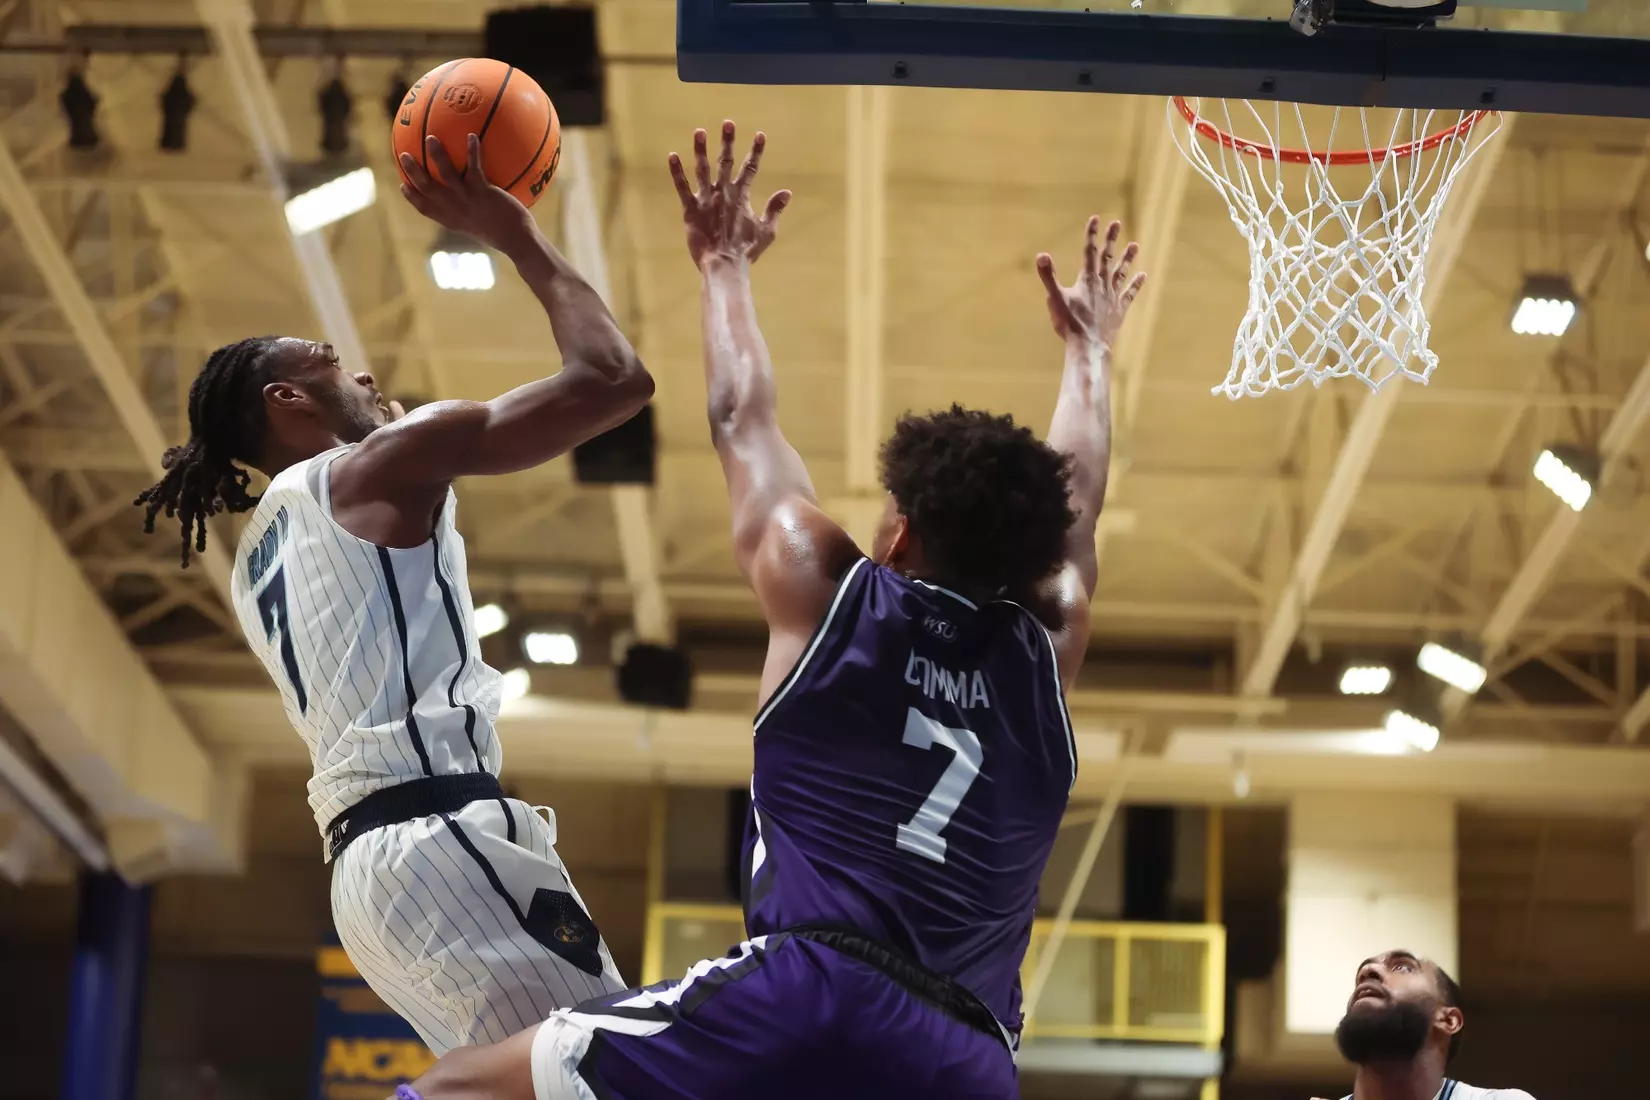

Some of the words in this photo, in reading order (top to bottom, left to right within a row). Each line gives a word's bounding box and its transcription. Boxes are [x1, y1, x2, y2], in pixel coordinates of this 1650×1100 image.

[257, 561, 307, 718] 7
[924, 615, 955, 640] WSU
[896, 706, 984, 864] 7
